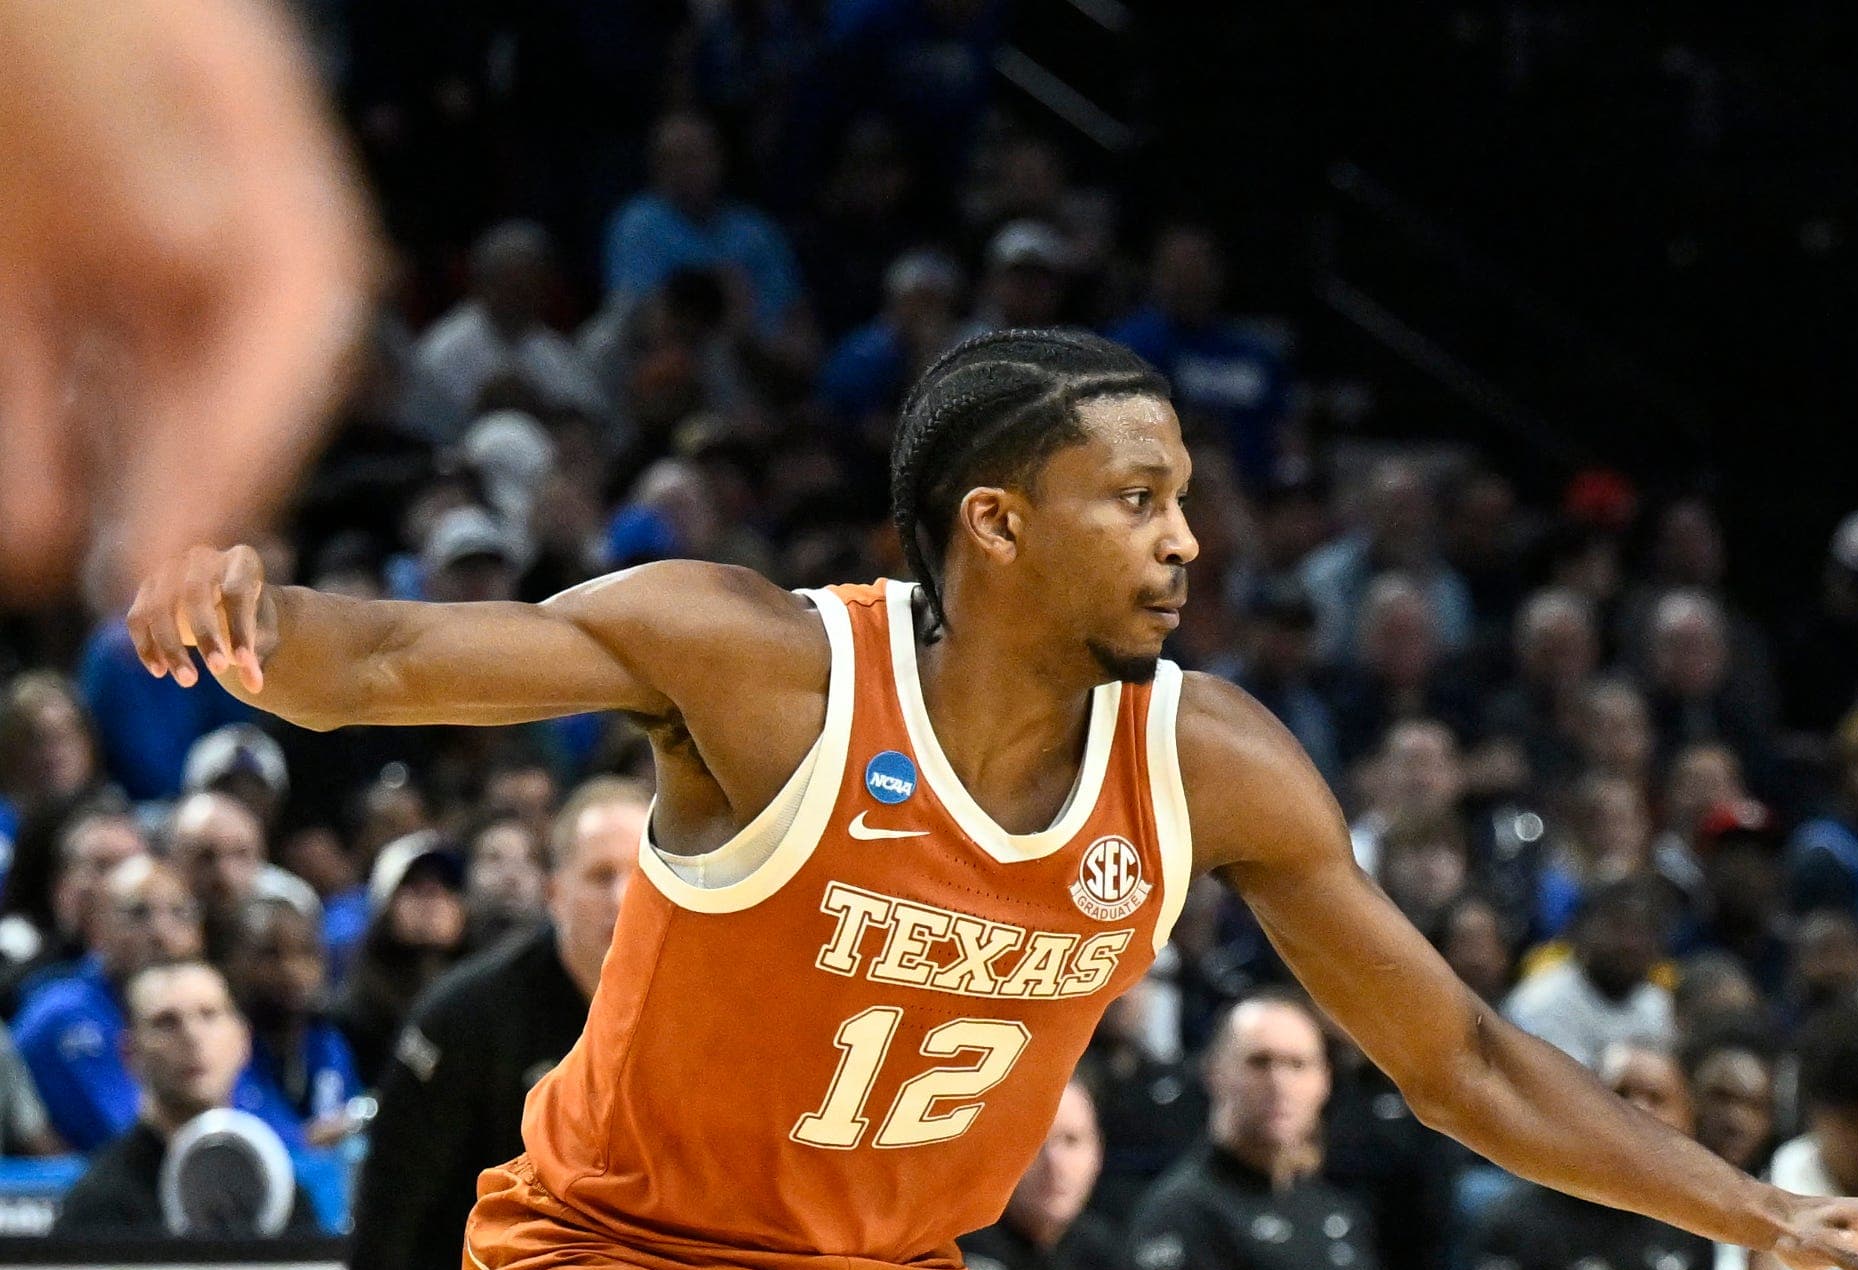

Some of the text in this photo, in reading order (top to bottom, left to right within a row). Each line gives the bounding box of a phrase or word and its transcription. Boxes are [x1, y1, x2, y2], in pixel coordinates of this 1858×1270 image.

[871, 772, 912, 796] NCAA
[1086, 841, 1136, 900] SEC
[1077, 895, 1141, 920] GRADUATE
[815, 880, 1136, 1000] TEXAS
[790, 1006, 1032, 1150] 12
